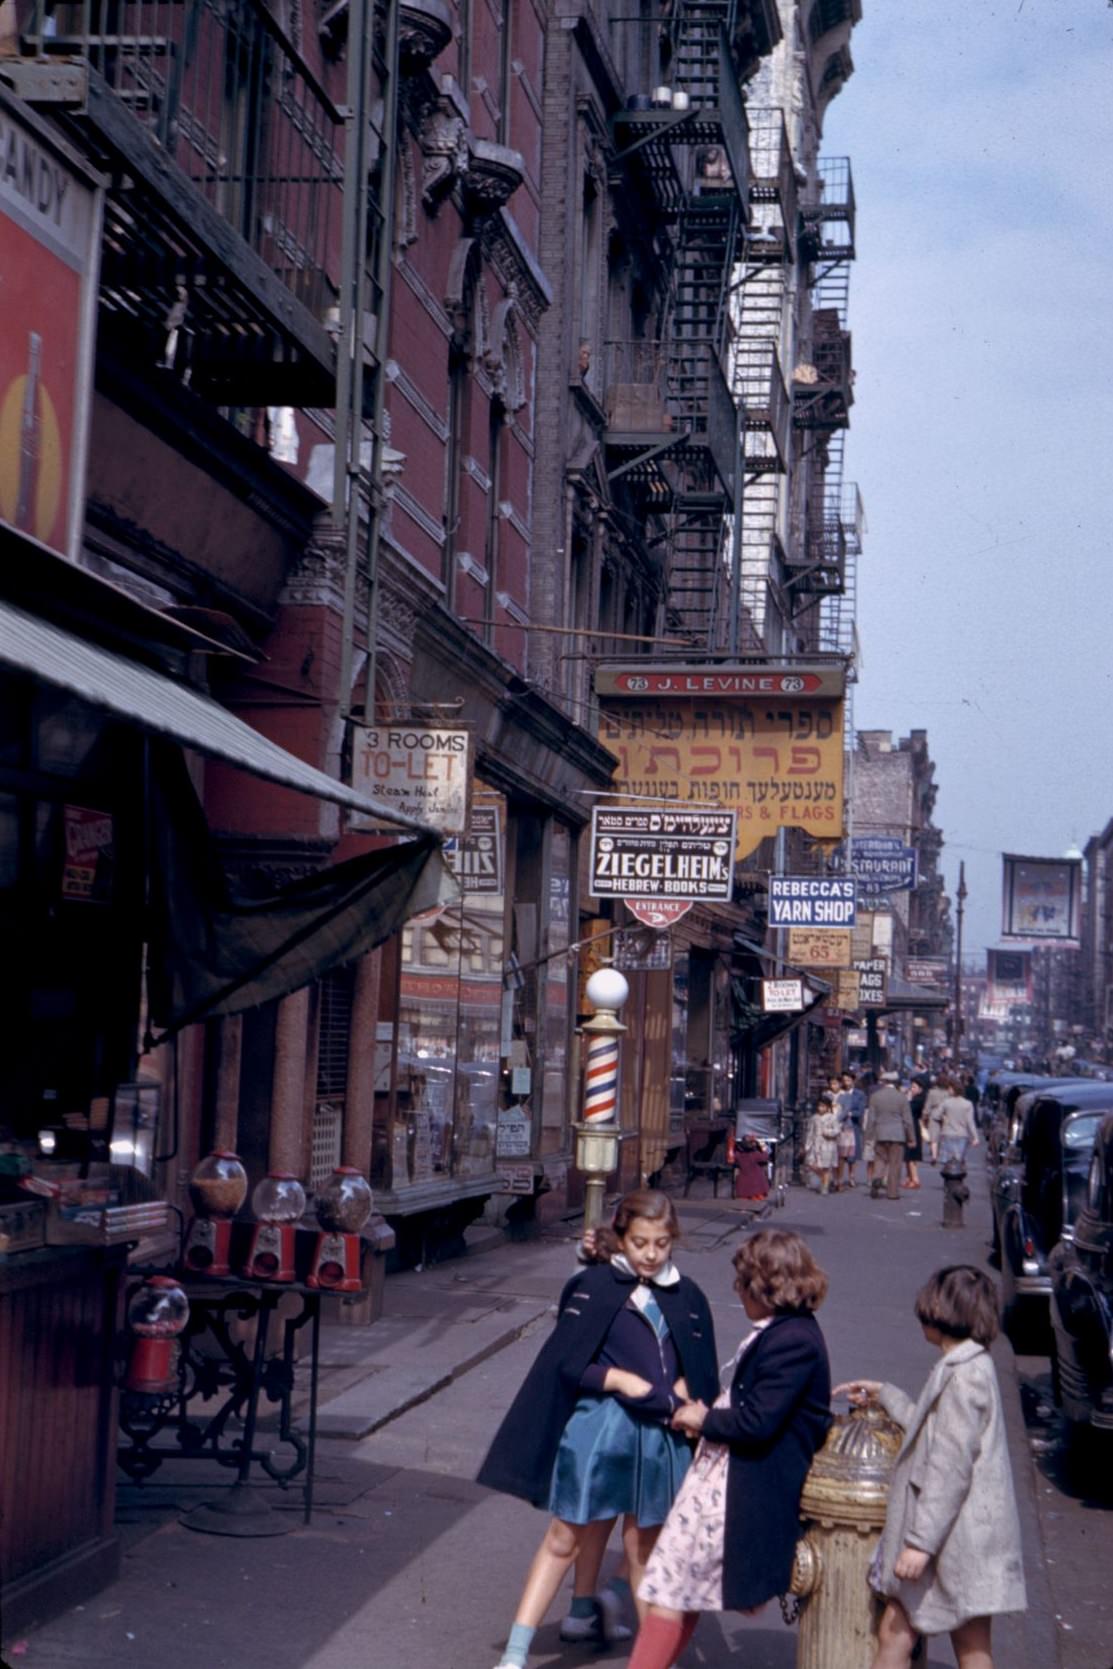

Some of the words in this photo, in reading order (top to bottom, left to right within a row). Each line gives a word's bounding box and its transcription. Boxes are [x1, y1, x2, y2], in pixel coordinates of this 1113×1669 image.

[0, 116, 71, 227] ANDY
[631, 678, 646, 690] 73
[658, 678, 678, 690] J.
[687, 678, 773, 690] LEVINE
[785, 678, 801, 690] 73
[367, 732, 379, 748] 3
[388, 733, 465, 751] ROOMS
[361, 751, 457, 780] TO-LET
[760, 806, 770, 819] &
[780, 806, 835, 820] FLAGS
[612, 878, 660, 892] HEBREW
[664, 880, 708, 893] BOOKS
[772, 881, 854, 897] REBECCA'S
[635, 901, 680, 912] ENTRANCE
[773, 901, 812, 922] YARN
[815, 901, 854, 922] SHOP
[861, 973, 882, 987] AGS
